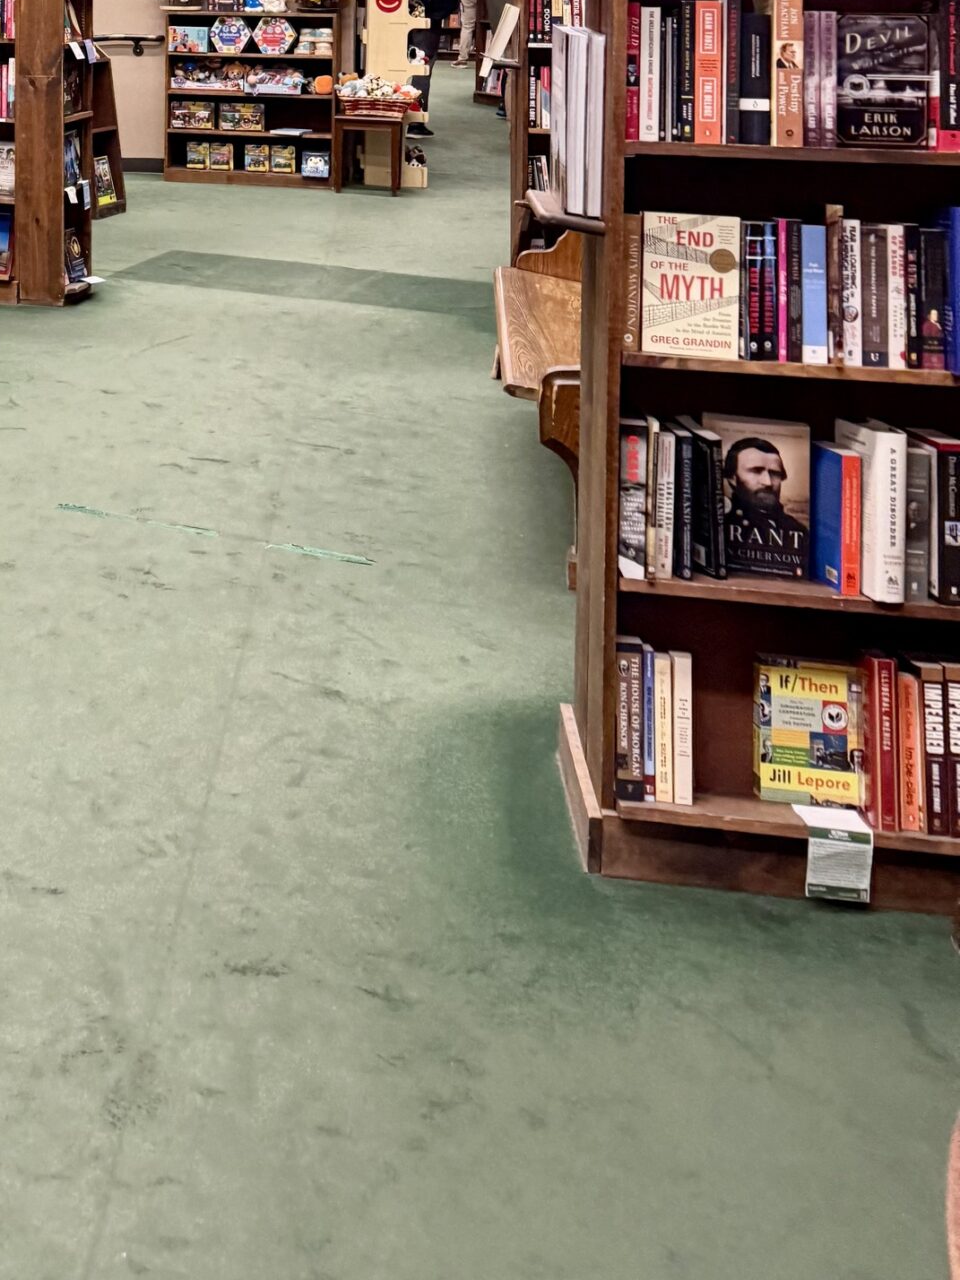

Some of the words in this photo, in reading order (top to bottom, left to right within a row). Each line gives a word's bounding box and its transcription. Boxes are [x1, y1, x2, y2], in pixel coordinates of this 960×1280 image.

[790, 8, 798, 24] JON
[845, 26, 912, 54] DEVIL
[704, 81, 712, 93] THE
[788, 75, 800, 113] Destiny
[778, 86, 787, 117] Power
[864, 113, 898, 123] ERIK
[851, 126, 911, 136] LARSON
[657, 216, 677, 225] THE
[676, 230, 714, 247] END
[650, 261, 665, 269] OF
[668, 262, 688, 271] THE
[660, 273, 723, 301] MYTH
[651, 335, 679, 346] GREG
[682, 337, 731, 349] GRANDIN
[631, 657, 639, 678] THE
[779, 673, 839, 696] If/Then
[631, 680, 639, 713] HOUSE
[620, 702, 628, 750] CHERNOW
[632, 715, 639, 729] OF
[924, 682, 944, 755] IMPEACHED
[632, 732, 640, 776] MORGAN
[769, 769, 791, 785] Jill
[796, 771, 851, 793] Lepore
